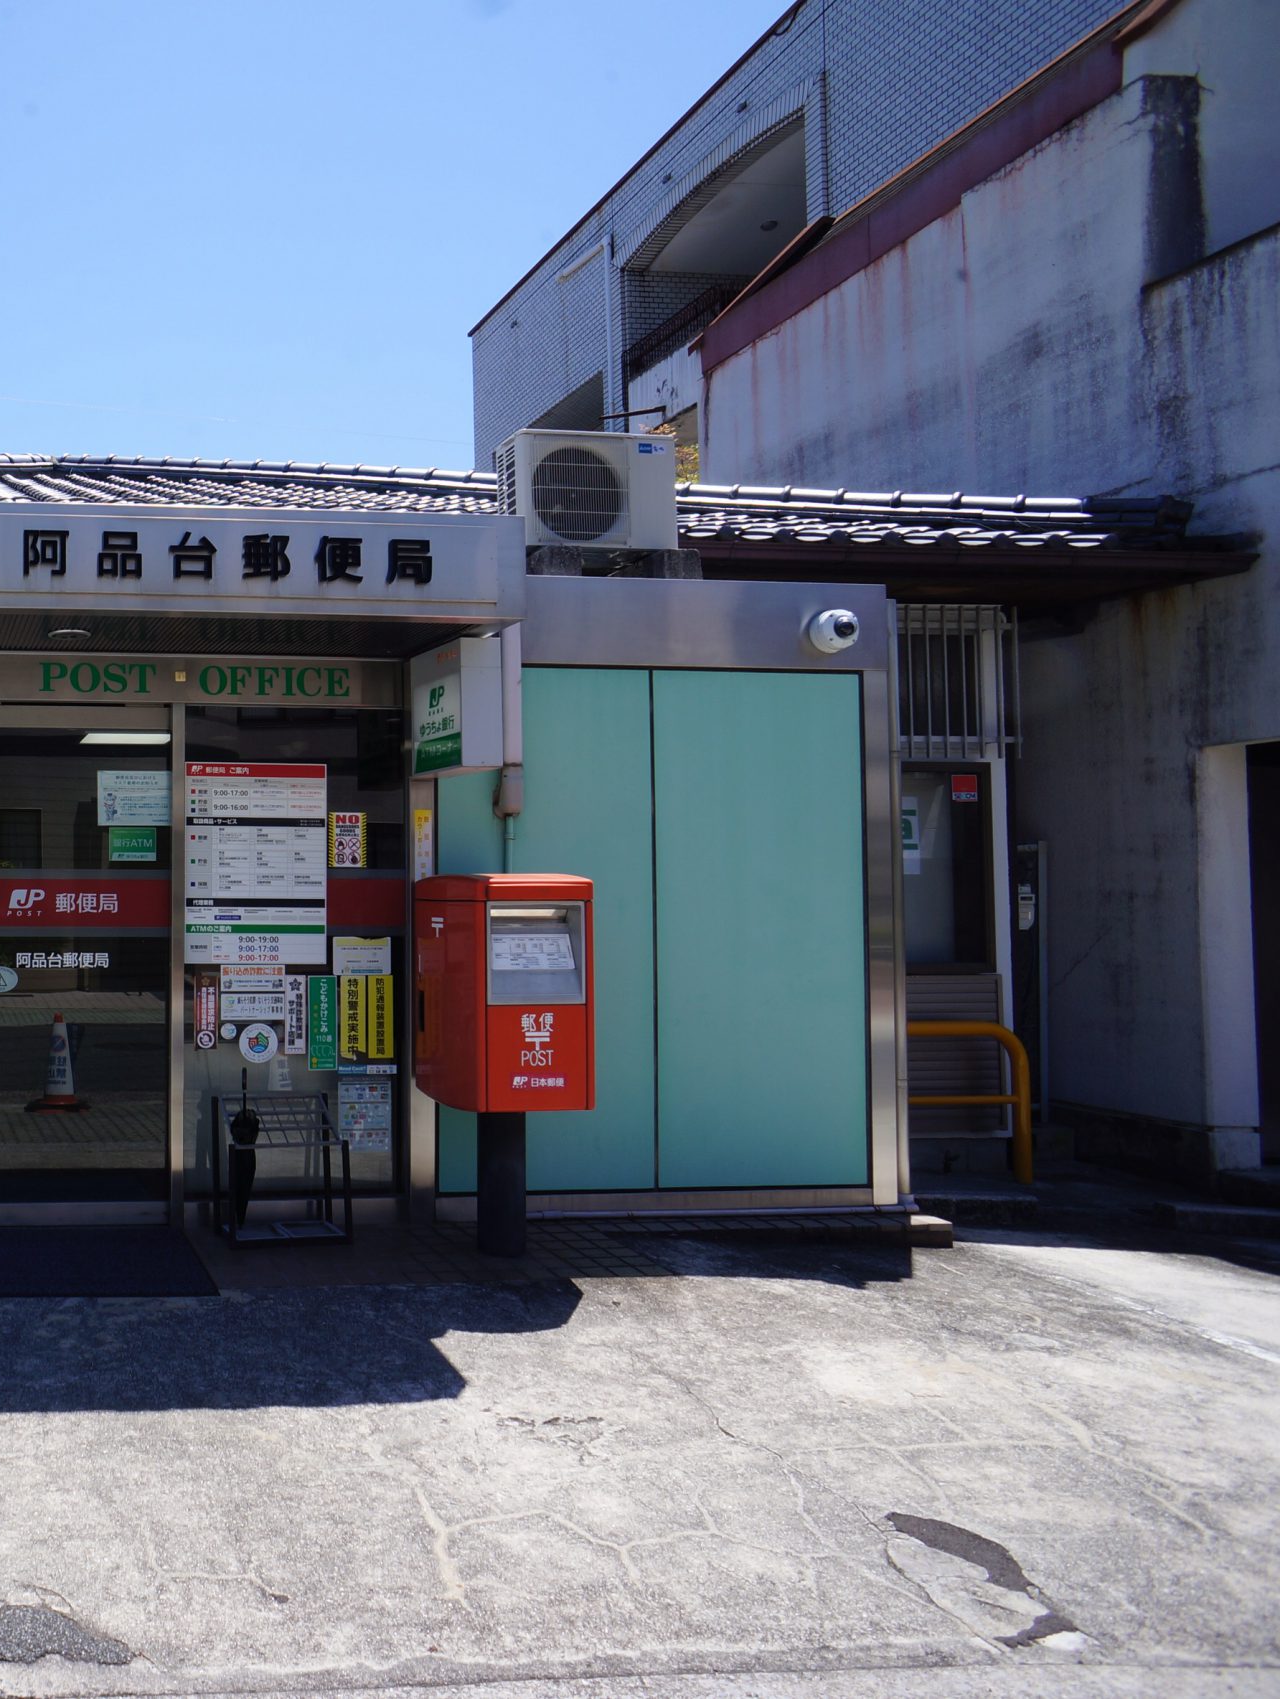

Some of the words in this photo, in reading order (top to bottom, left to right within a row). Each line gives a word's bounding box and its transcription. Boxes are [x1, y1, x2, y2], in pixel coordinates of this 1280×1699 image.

[22, 529, 434, 585] 阿品台郵便局
[38, 662, 156, 695] POST
[199, 664, 350, 698] OFFICE
[420, 715, 455, 738] ゆうちょ銀行
[229, 767, 249, 775] ご案内
[336, 815, 360, 824] NO
[55, 892, 119, 914] 郵便局
[16, 952, 110, 969] 阿品台郵便局
[320, 978, 328, 1033] こどもかけこみ
[521, 1013, 554, 1032] 郵便
[316, 1035, 333, 1043] 110番
[521, 1050, 554, 1066] POST
[530, 1077, 565, 1088] 日本郵便
